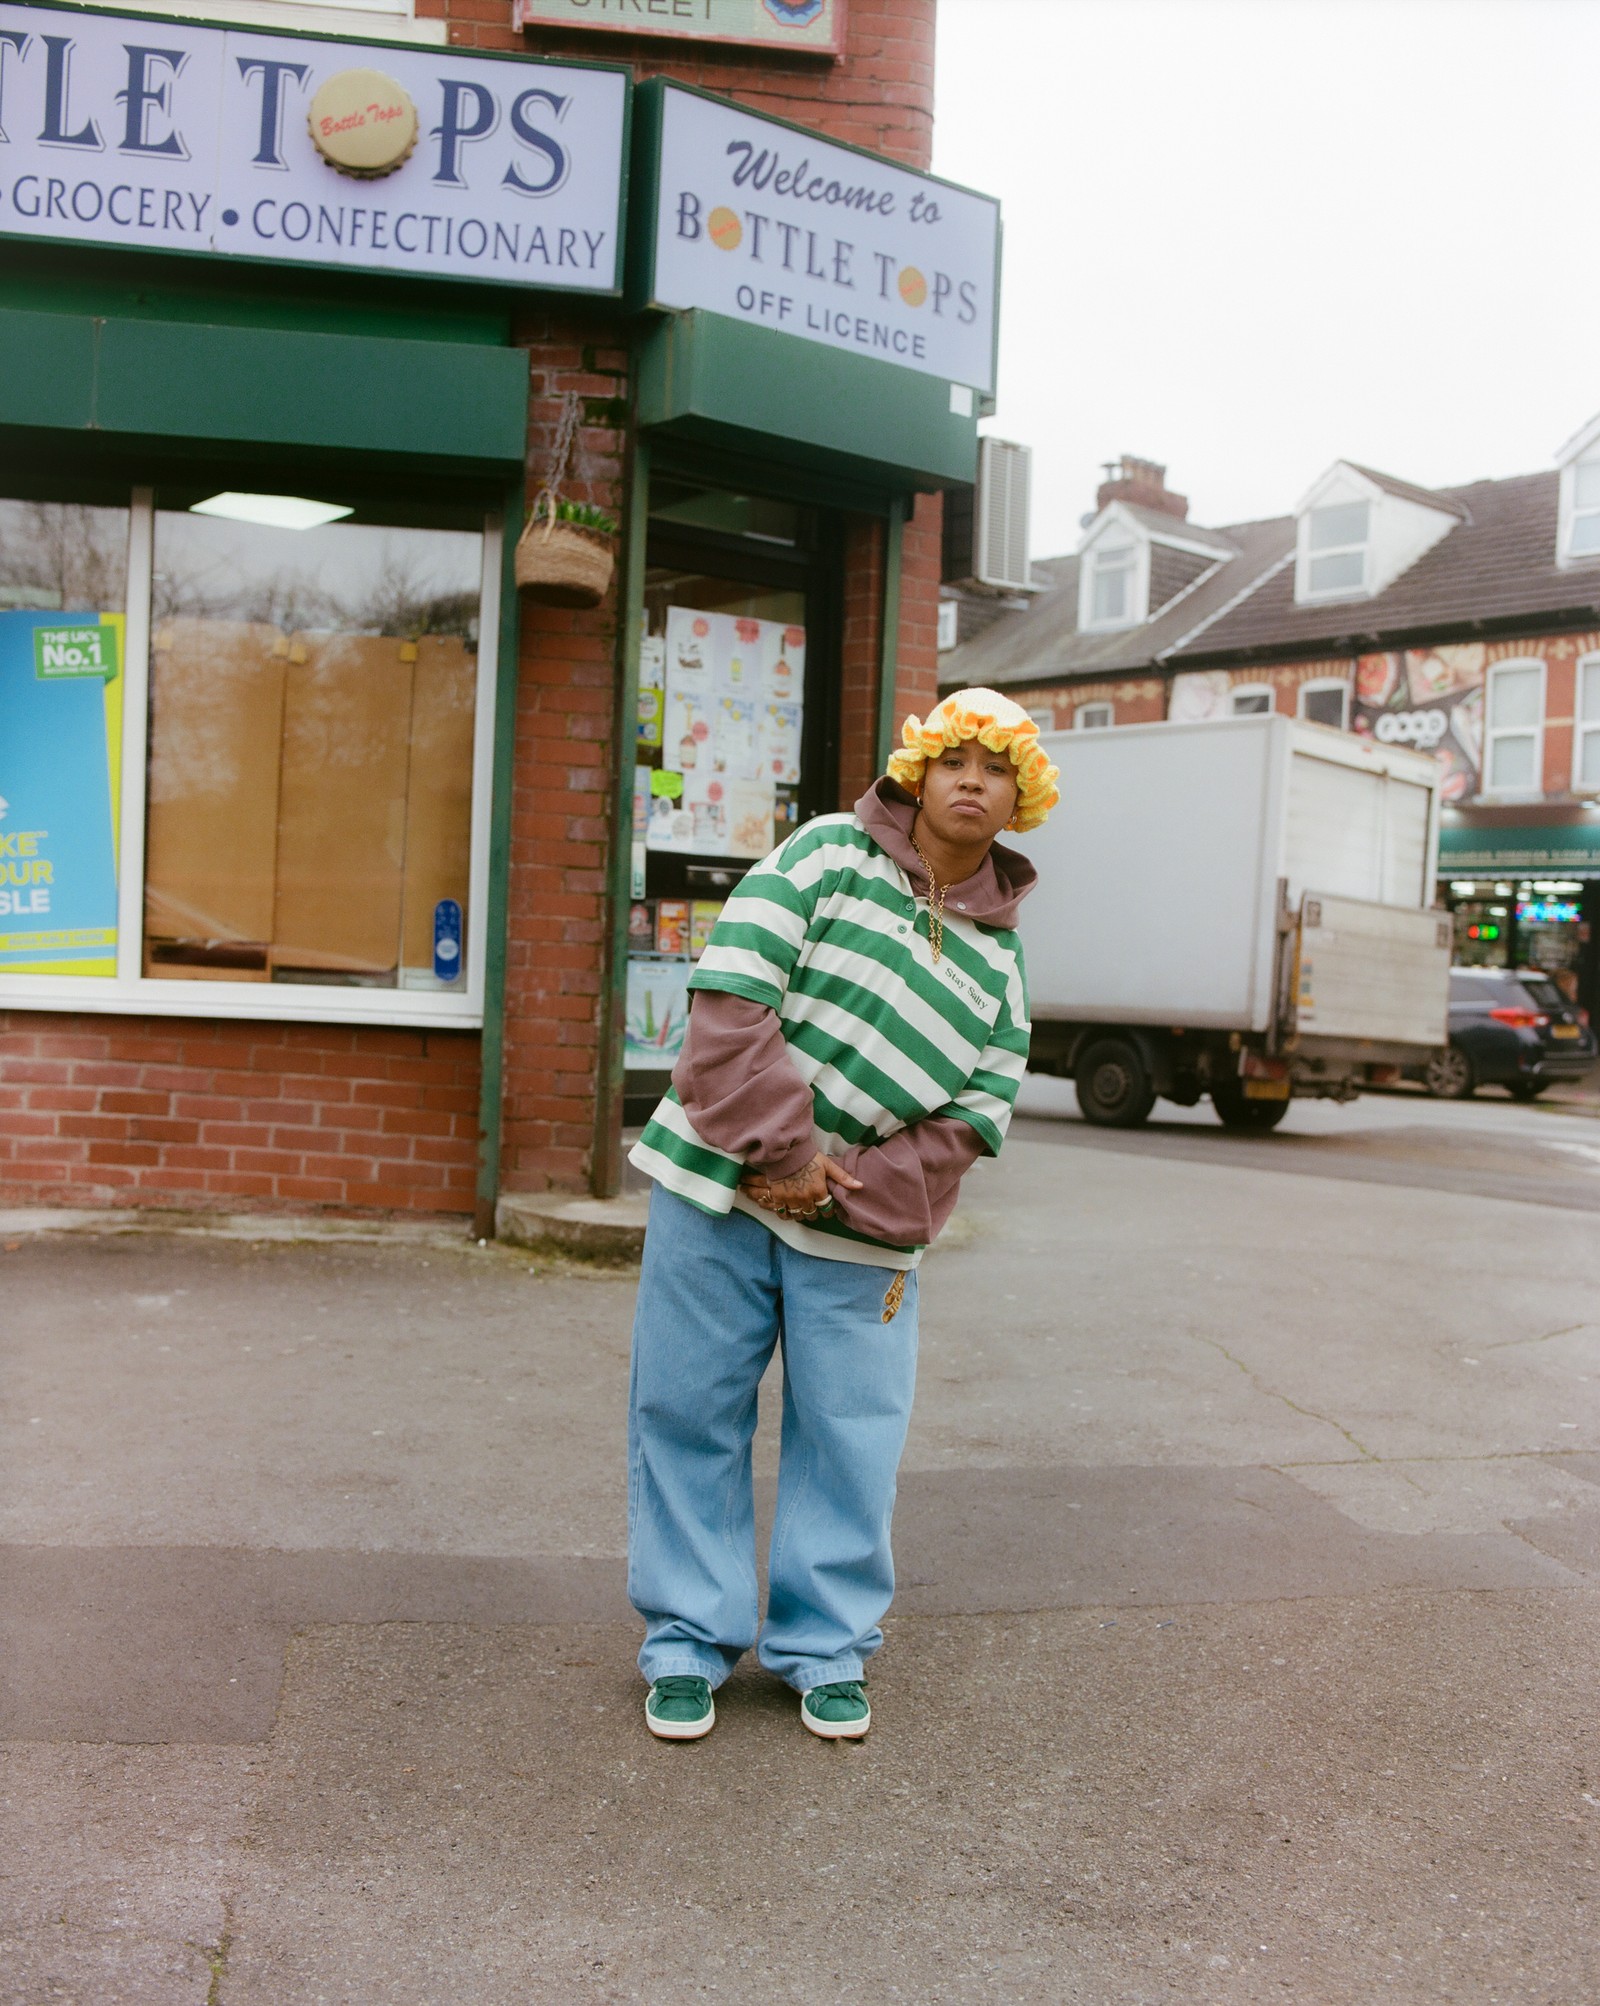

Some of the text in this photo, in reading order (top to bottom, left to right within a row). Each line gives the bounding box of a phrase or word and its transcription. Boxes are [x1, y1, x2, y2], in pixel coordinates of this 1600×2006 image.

[726, 140, 942, 224] Welcome to
[12, 175, 605, 269] GROCERY CONFECTIONARY
[737, 284, 927, 360] OFF LICENCE
[43, 642, 102, 667] No.1
[945, 967, 989, 1009] Stay Salty
